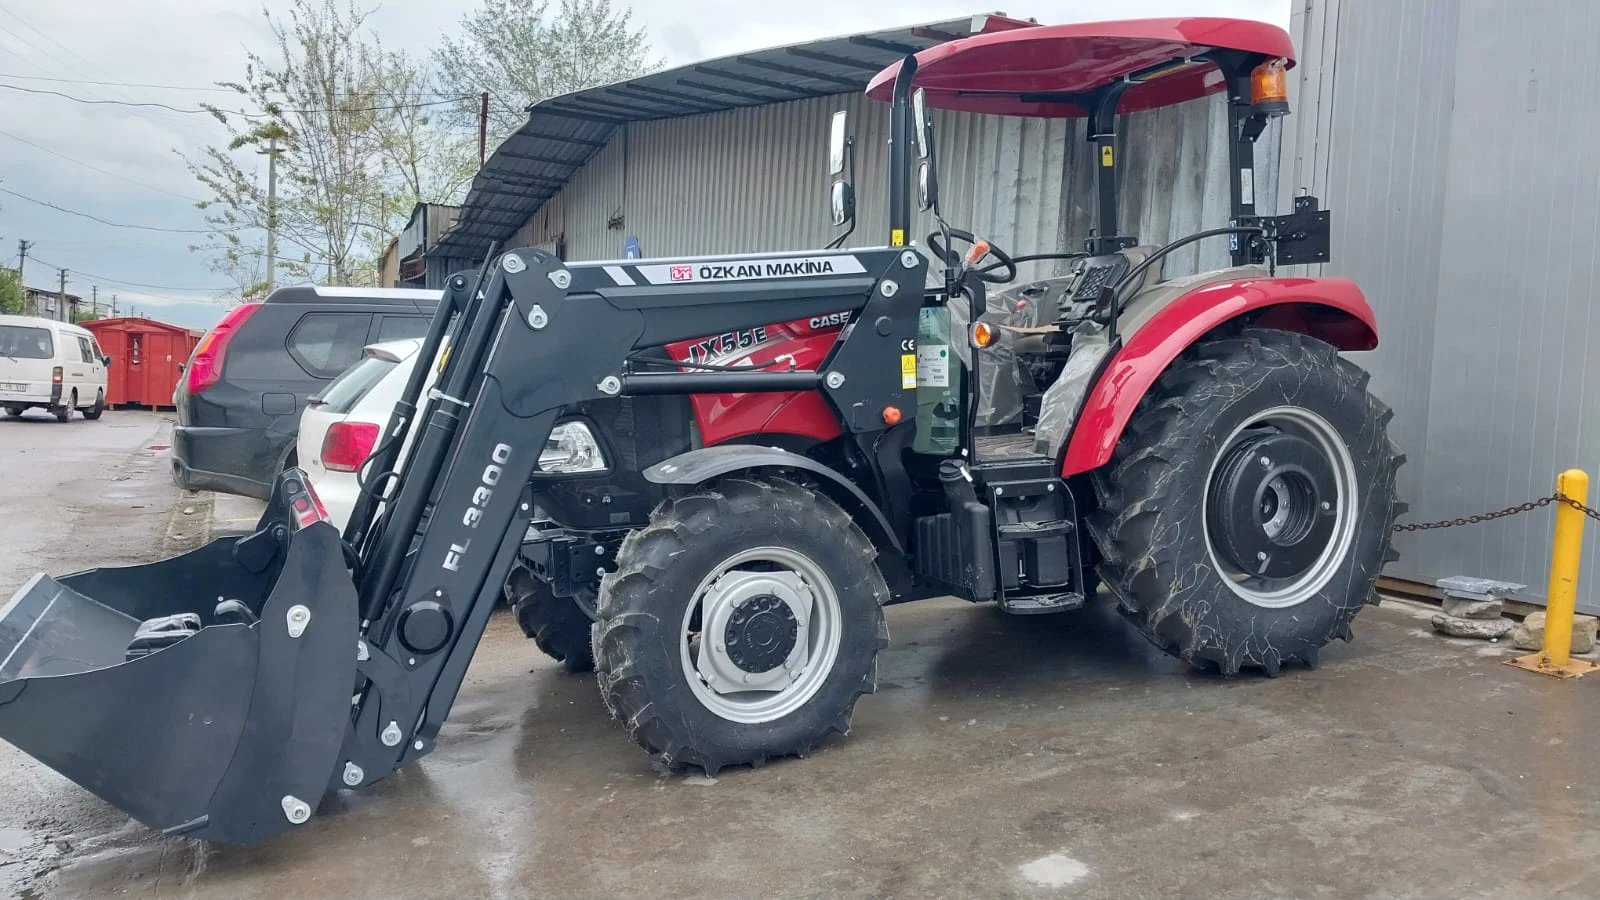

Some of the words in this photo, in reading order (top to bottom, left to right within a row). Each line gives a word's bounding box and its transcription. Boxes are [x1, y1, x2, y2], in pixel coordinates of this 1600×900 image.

[700, 264, 762, 279] ÖZKAN
[766, 259, 834, 276] MAKİNA
[809, 311, 850, 329] CASE
[688, 326, 768, 364] JX55E
[901, 339, 915, 351] CE
[441, 538, 472, 572] FL
[462, 443, 513, 529] 3300
